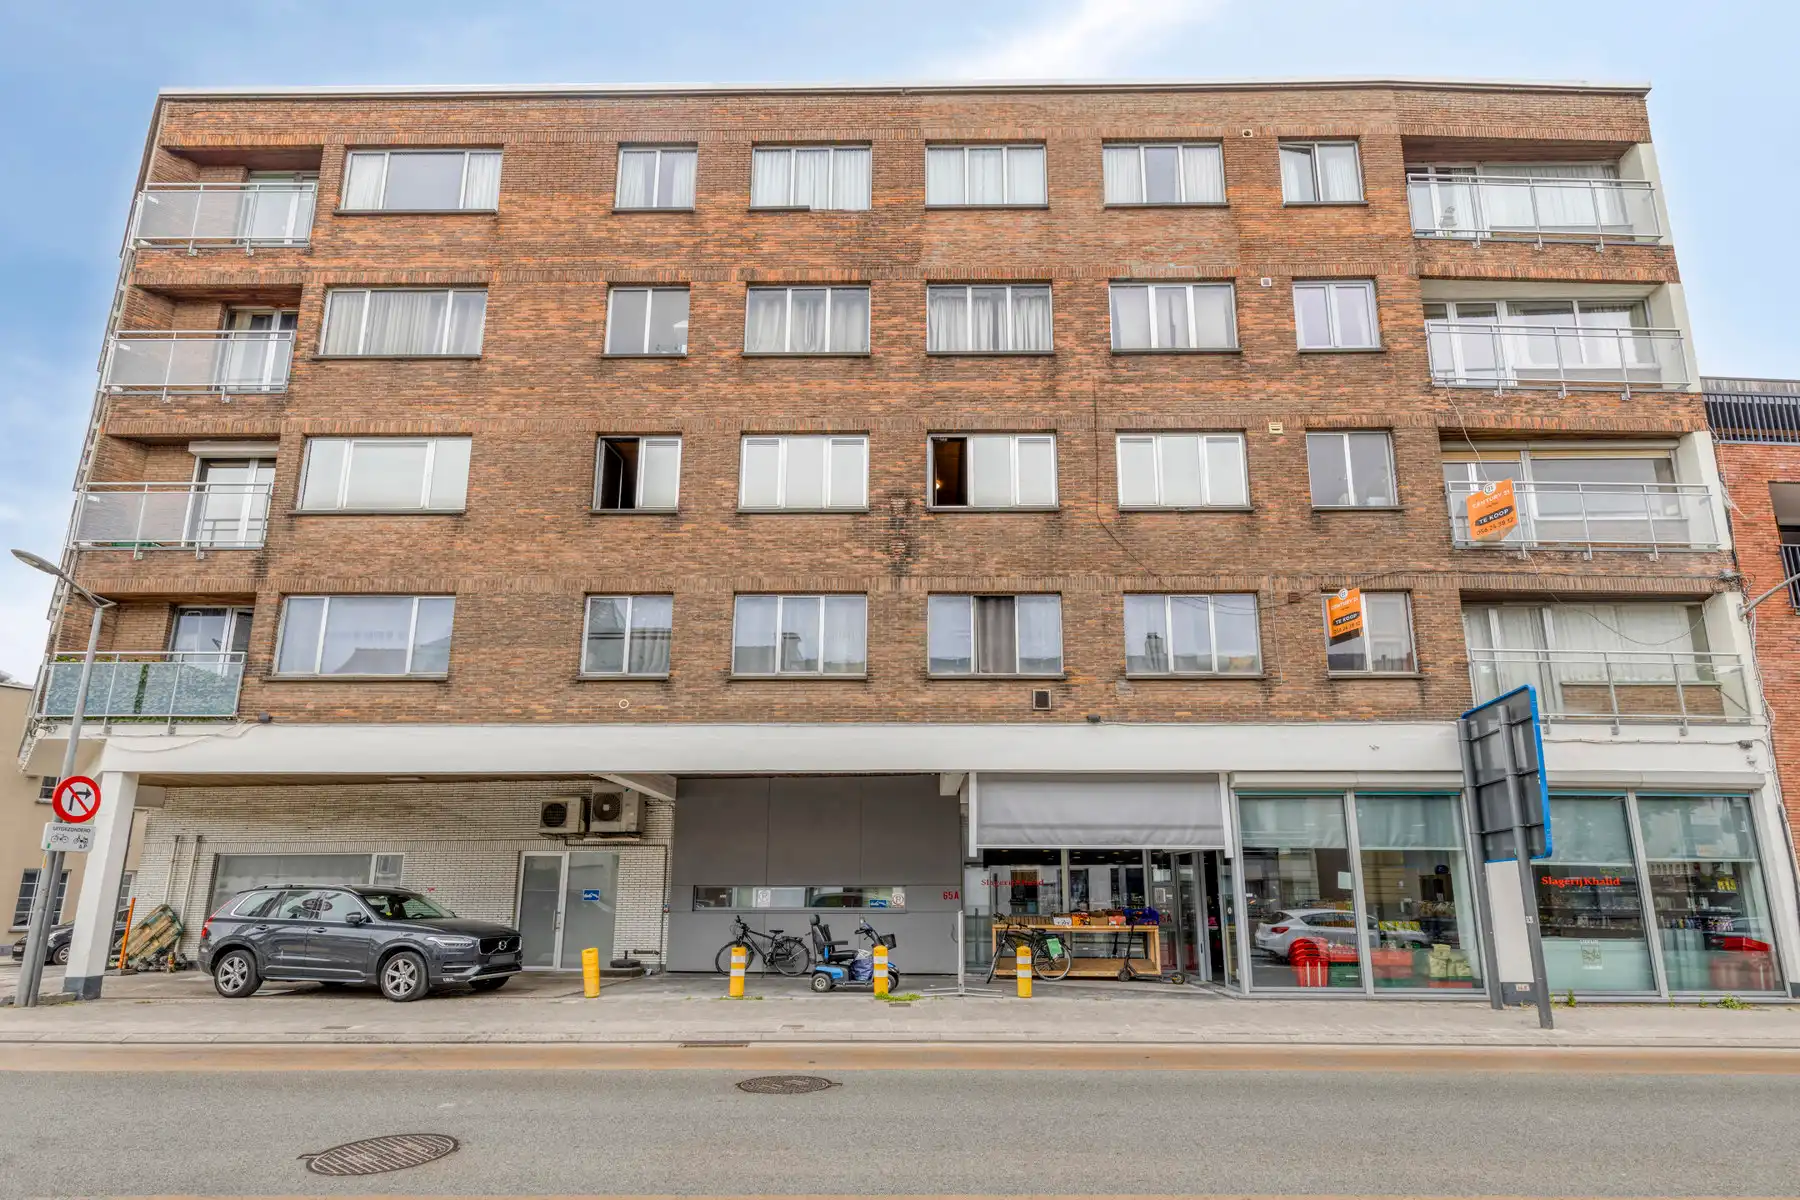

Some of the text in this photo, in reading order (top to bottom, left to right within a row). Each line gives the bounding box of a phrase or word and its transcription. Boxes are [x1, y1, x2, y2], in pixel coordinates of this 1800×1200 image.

[1472, 492, 1503, 509] CENTURY
[1479, 508, 1510, 525] TE KOOP
[1342, 613, 1358, 623] KOOP
[1541, 876, 1621, 888] Slagerij Khalid
